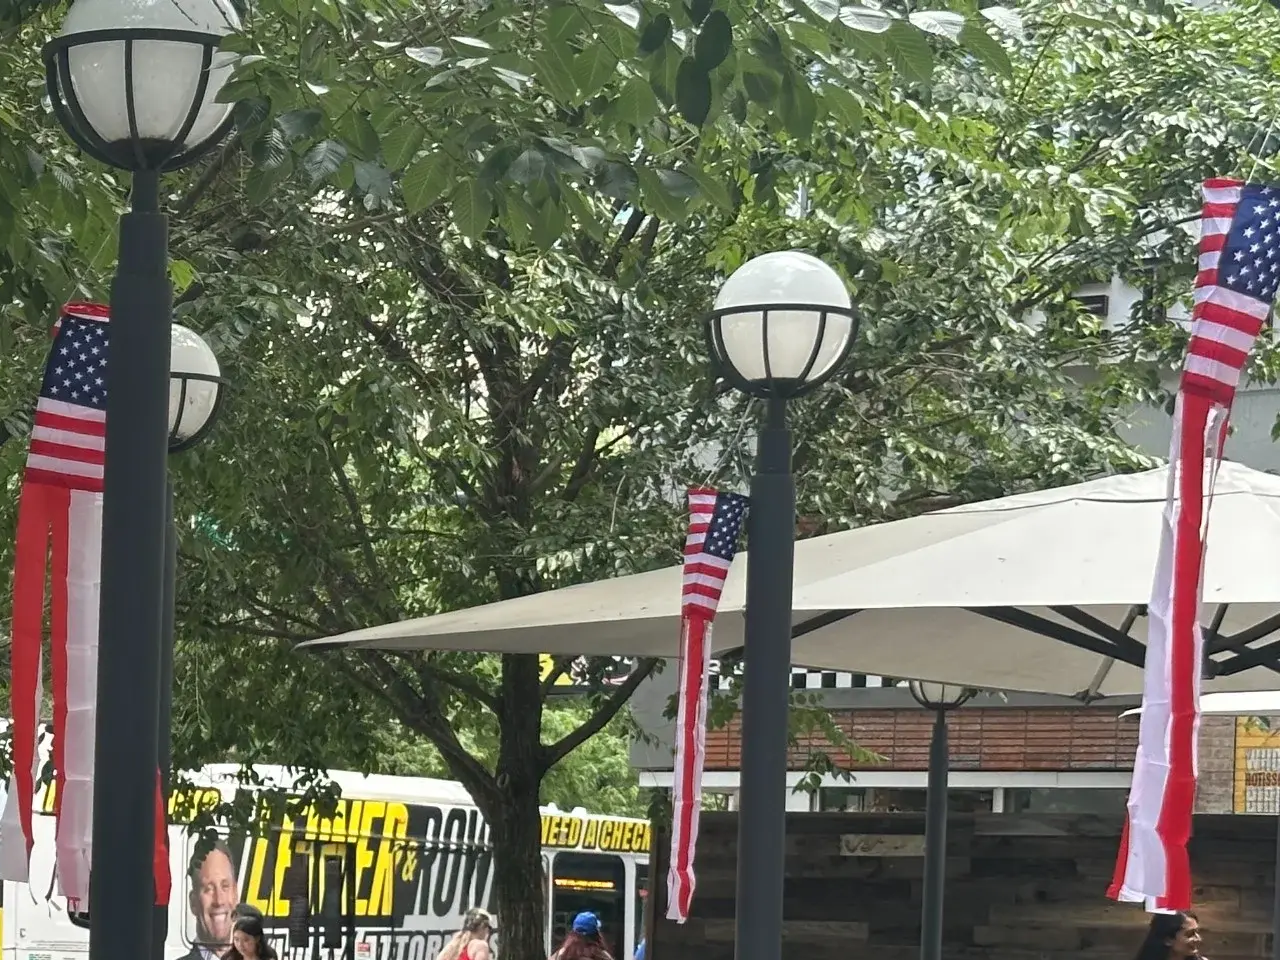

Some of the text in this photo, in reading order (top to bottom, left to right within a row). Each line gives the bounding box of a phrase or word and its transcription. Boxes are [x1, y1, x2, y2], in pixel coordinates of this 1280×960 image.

[413, 806, 498, 918] ROW
[541, 815, 651, 853] NEED A CHECK
